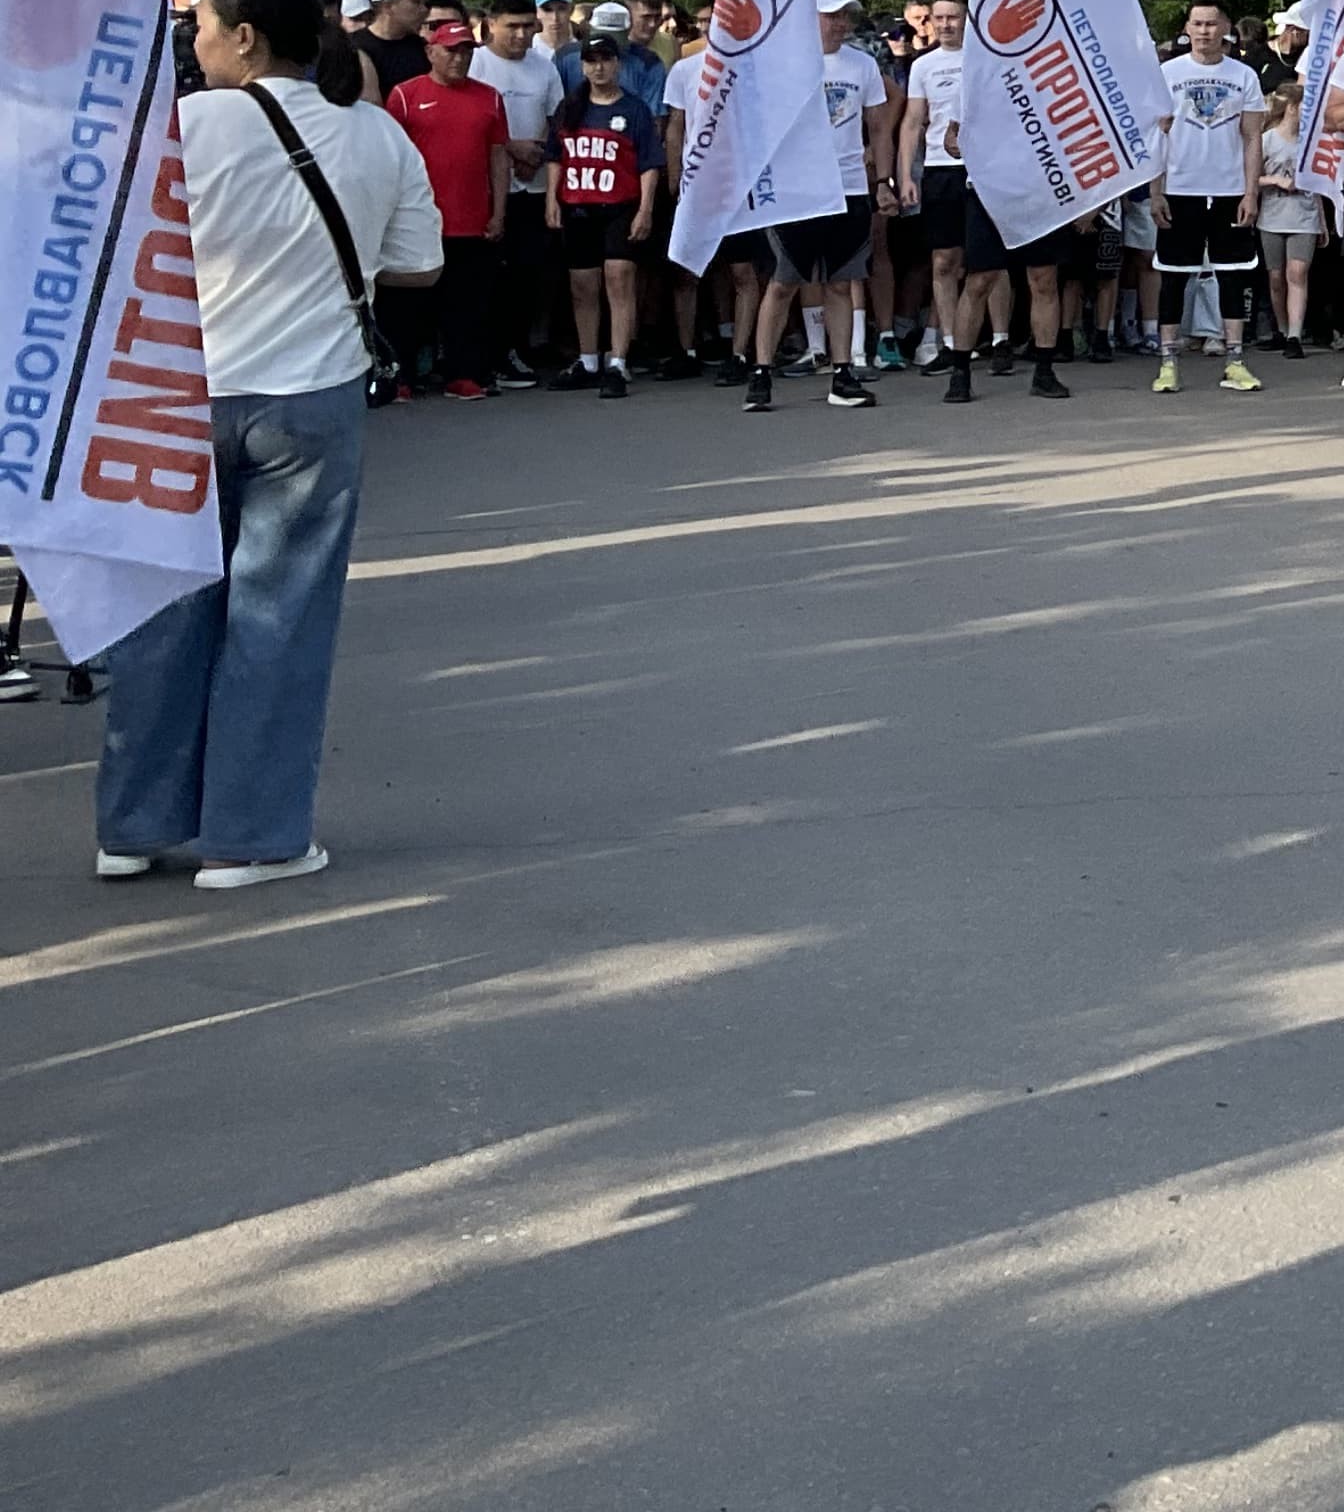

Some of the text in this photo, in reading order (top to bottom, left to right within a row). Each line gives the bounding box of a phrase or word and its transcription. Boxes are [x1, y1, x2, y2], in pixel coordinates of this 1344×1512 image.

[1001, 67, 1076, 207] НАРКОТИКОВ!
[1024, 39, 1121, 191] ПРОТИВ
[1069, 7, 1151, 166] ПЕТРОПАВЛОВСК
[567, 167, 615, 192] SKO
